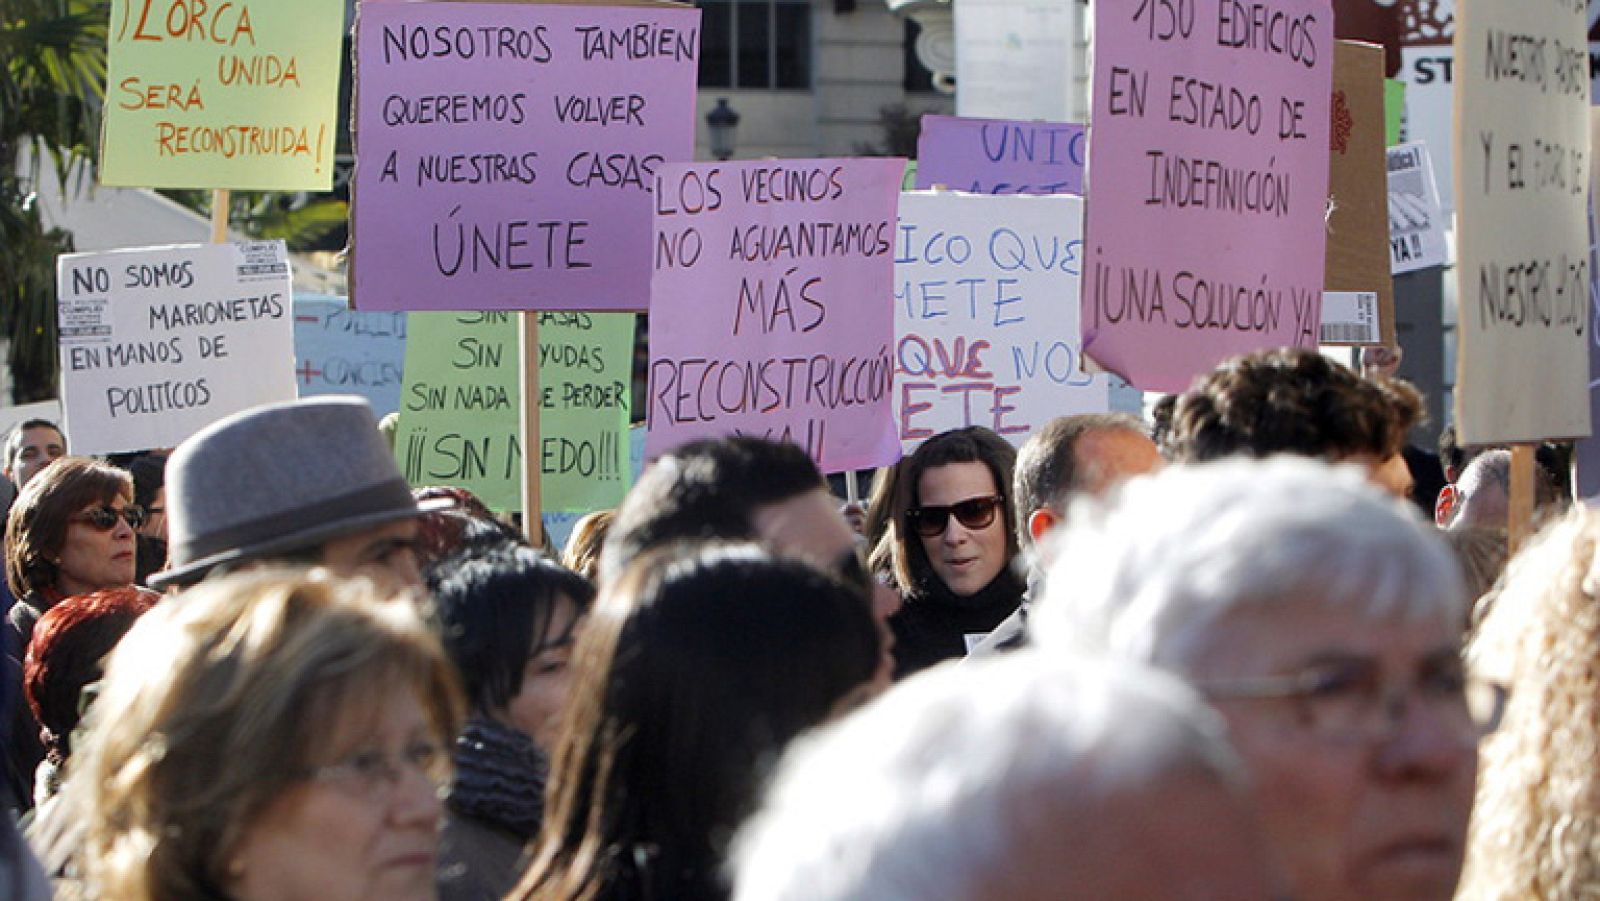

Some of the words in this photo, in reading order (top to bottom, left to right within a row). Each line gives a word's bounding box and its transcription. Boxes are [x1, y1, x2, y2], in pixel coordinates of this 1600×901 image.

[383, 25, 552, 64] NOSOTROS
[1218, 0, 1317, 68] EDIFICIOS
[118, 77, 204, 111] SERÁ
[219, 55, 300, 88] UNIDA
[383, 94, 527, 126] QUEREMOS
[554, 94, 646, 126] VOLVER
[1109, 66, 1148, 117] EN
[1169, 75, 1261, 135] ESTADO
[1279, 96, 1306, 140] DE
[156, 122, 325, 173] RECONSTRUIDA!
[380, 150, 399, 183] A
[418, 153, 538, 188] NUESTRAS
[657, 169, 721, 215] LOS
[742, 167, 843, 203] VECINOS
[1146, 150, 1289, 217] INDEFINICIÓN
[433, 204, 592, 277] ÚNETE
[656, 228, 702, 270] NO
[730, 222, 890, 262] AGUANTAMOS
[989, 227, 1083, 275] QUE
[72, 267, 110, 295] NO
[125, 260, 193, 289] SOMOS
[149, 294, 283, 330] MARIONETAS
[734, 267, 825, 336] MÁS
[1173, 273, 1282, 334] SOLUCIÓN
[71, 348, 101, 371] EN
[106, 337, 183, 368] MANOS
[199, 335, 228, 358] DE
[452, 337, 503, 370] SIN
[896, 334, 993, 380] QUE
[407, 383, 446, 411] SIN
[454, 385, 510, 410] NADA
[562, 381, 627, 411] PERDER
[647, 345, 895, 432] RECONSTRUCCIÓN
